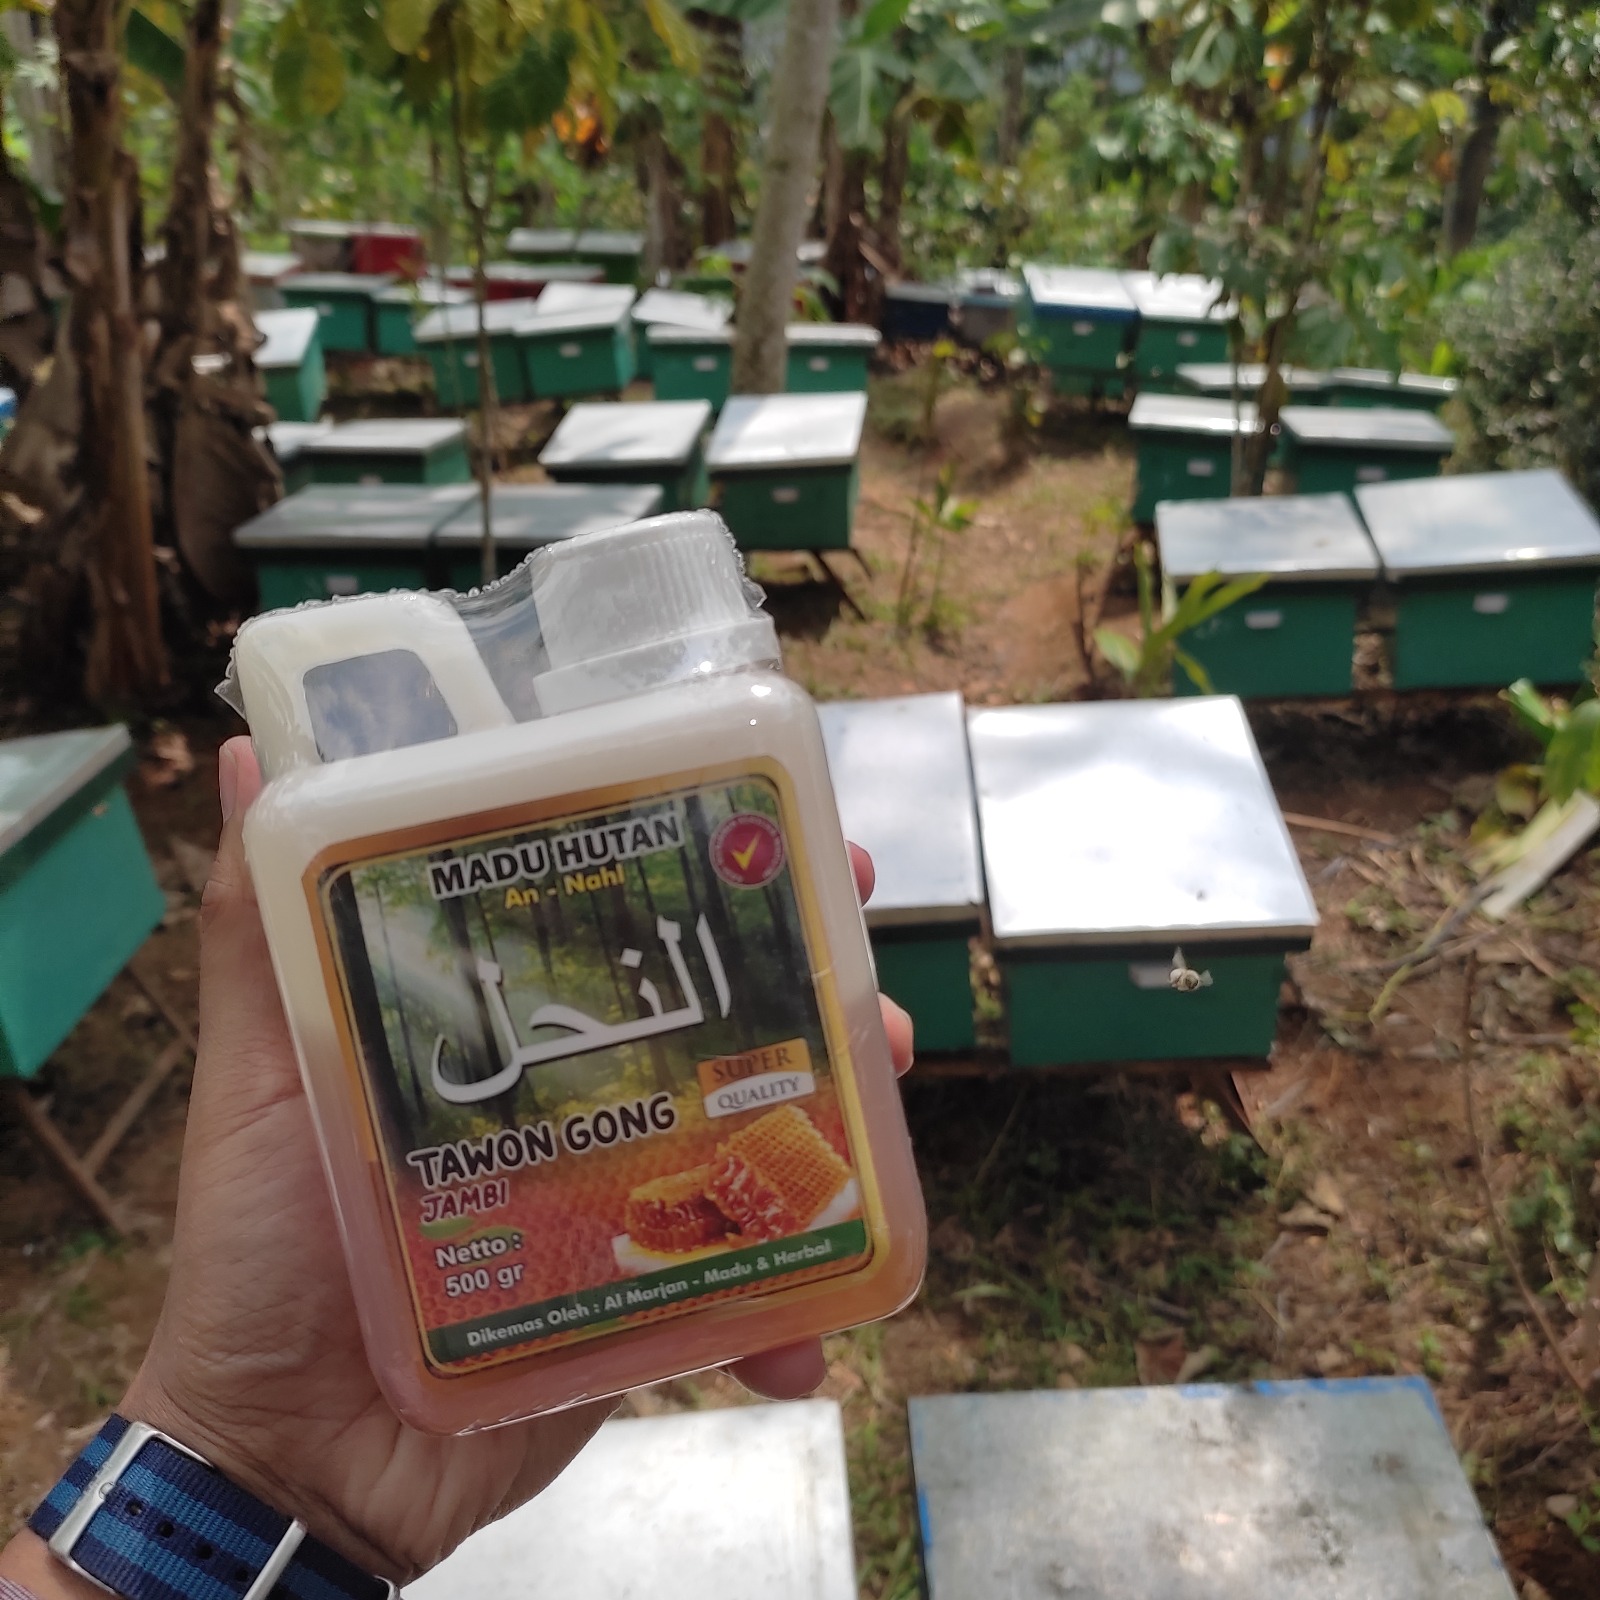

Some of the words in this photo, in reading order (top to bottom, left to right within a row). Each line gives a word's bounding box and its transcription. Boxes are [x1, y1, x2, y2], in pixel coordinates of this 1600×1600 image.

[429, 843, 547, 896] MADU
[554, 813, 682, 869] HUTAN
[504, 886, 540, 909] An
[563, 863, 626, 895] Nahl
[432, 912, 731, 1104] النحل
[713, 1047, 792, 1082] SUPER
[717, 1076, 800, 1109] QUALITY
[409, 1123, 554, 1187] TAWON
[563, 1094, 677, 1152] GONG
[421, 1180, 508, 1223] JAMBI
[435, 1236, 507, 1268] Netto
[445, 1269, 490, 1297] 500
[497, 1263, 524, 1289] gr
[466, 1317, 544, 1347] Dikemas
[547, 1303, 589, 1325] Oleh
[604, 1295, 622, 1311] Al
[627, 1278, 688, 1305] Marjan
[704, 1261, 752, 1284] Madu
[757, 1256, 769, 1271] &
[773, 1239, 832, 1266] Herbal
